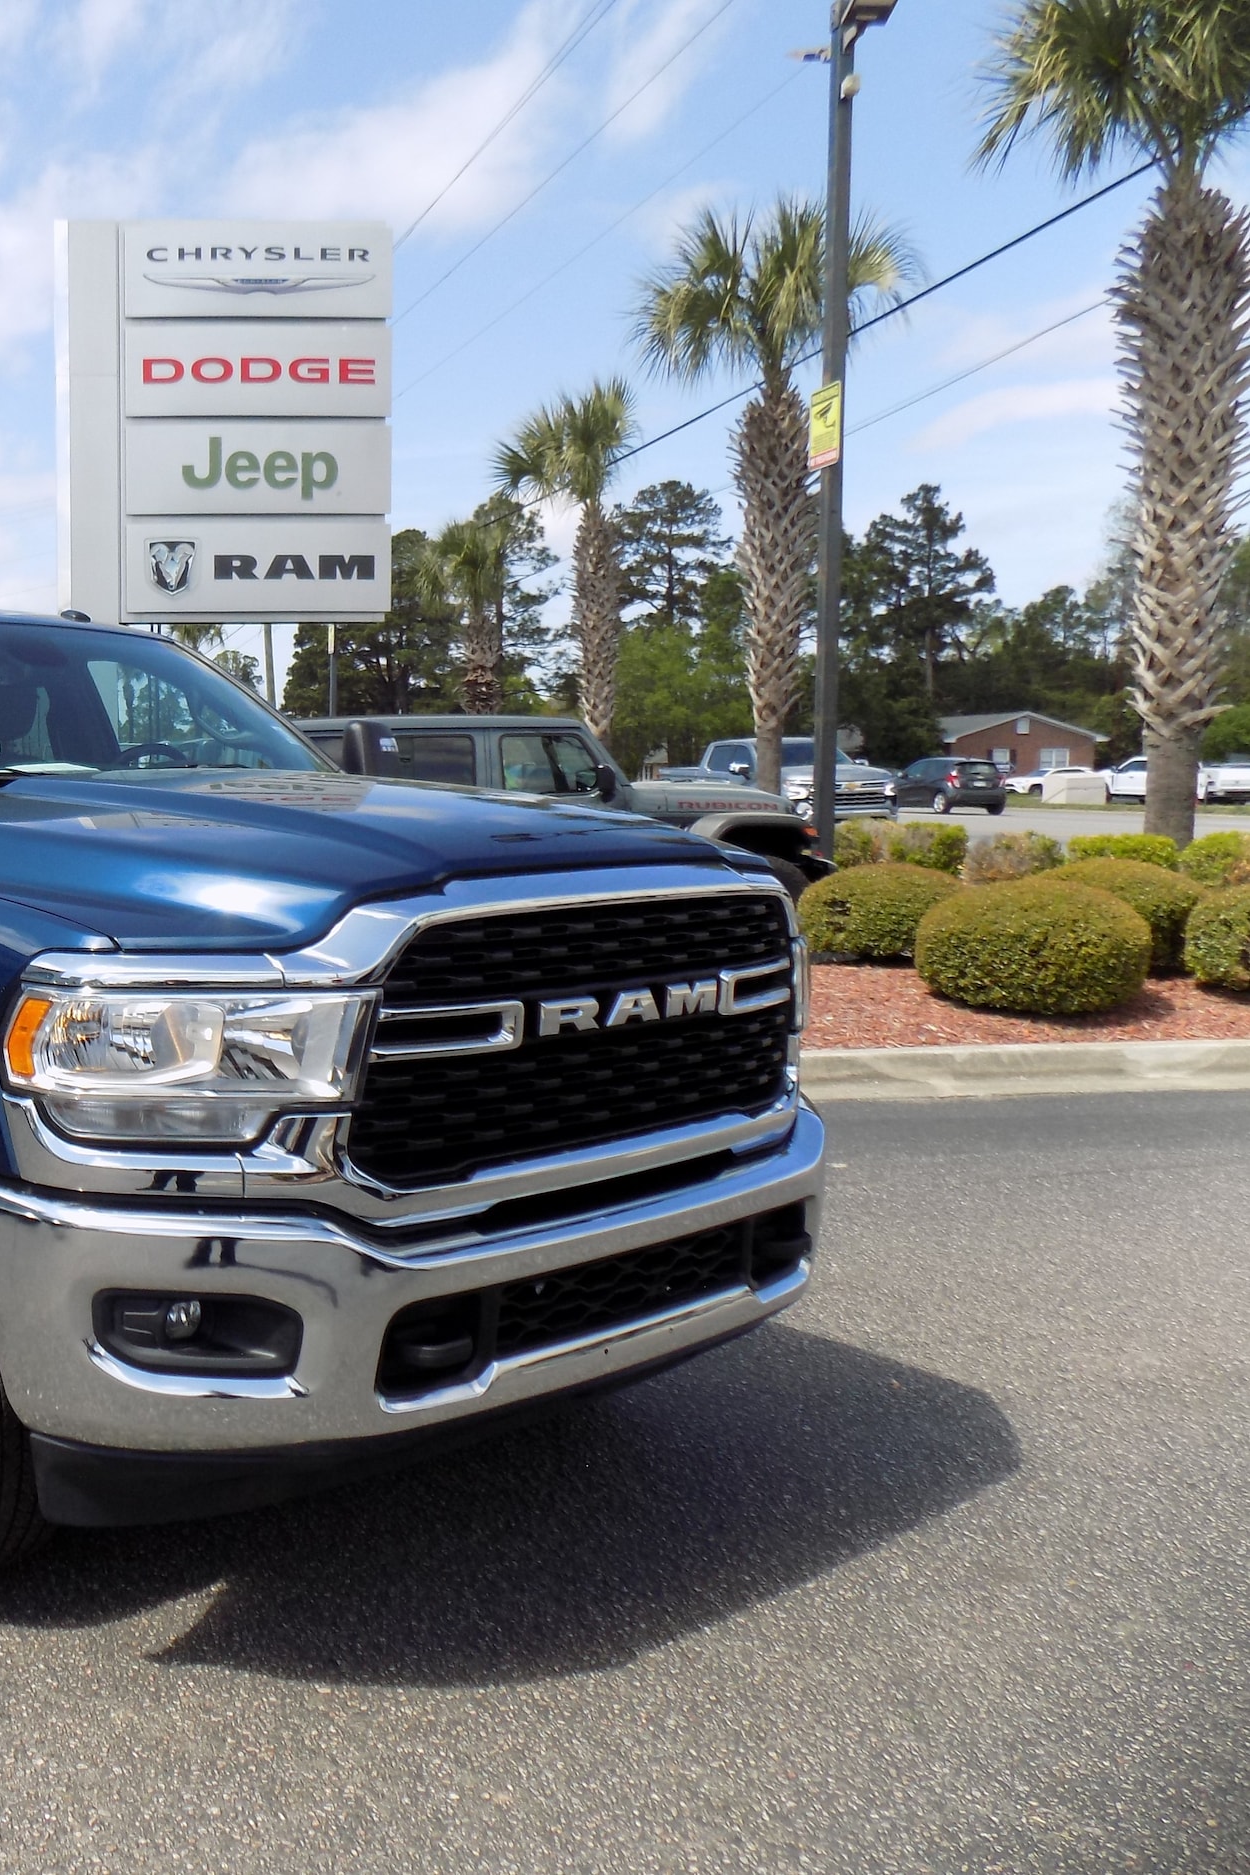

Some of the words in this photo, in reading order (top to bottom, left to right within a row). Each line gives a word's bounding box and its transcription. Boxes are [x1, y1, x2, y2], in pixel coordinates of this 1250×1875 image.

[146, 246, 371, 263] CHRYSLER
[142, 357, 376, 385] DODGE
[181, 436, 339, 501] Jeep
[213, 554, 376, 580] RAM
[677, 801, 778, 811] RUBICON
[539, 978, 718, 1037] RAM
